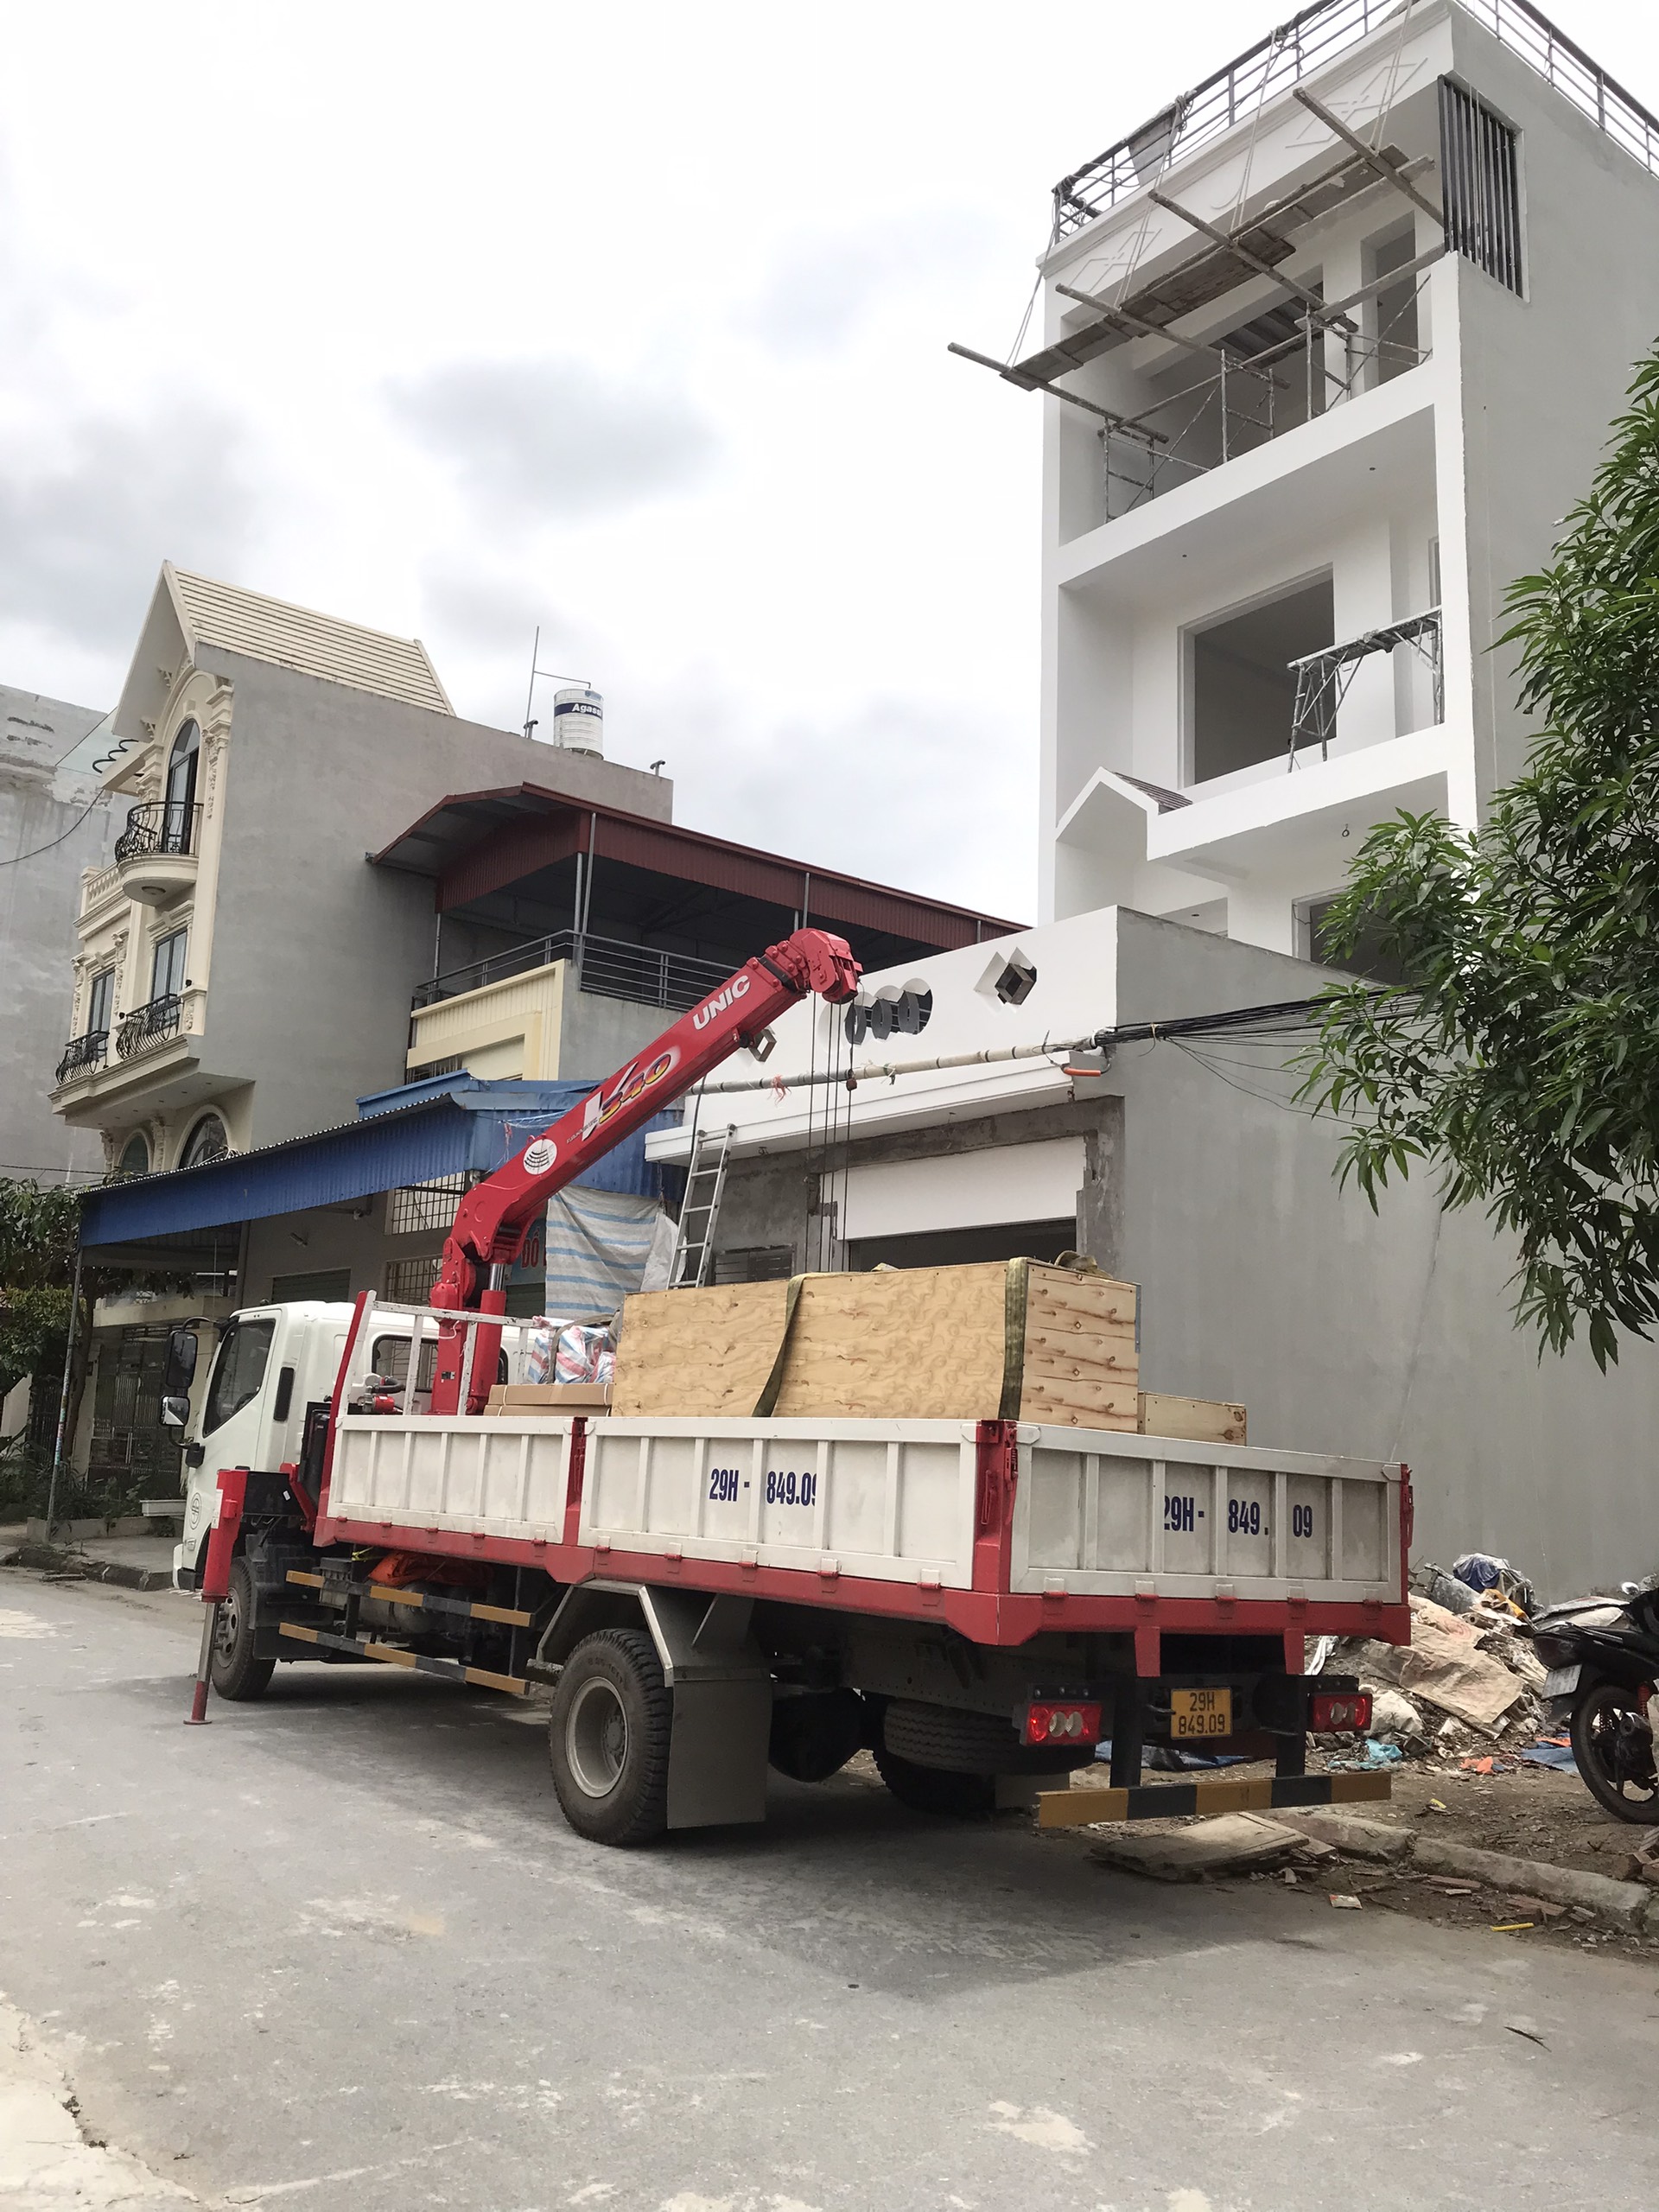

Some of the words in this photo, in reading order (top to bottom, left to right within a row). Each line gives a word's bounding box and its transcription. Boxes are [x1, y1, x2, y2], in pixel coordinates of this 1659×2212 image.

[692, 975, 751, 1031] UNIC
[1293, 1503, 1313, 1538] 09
[1189, 1691, 1216, 1712] 29H
[1178, 1713, 1226, 1735] 849.09
